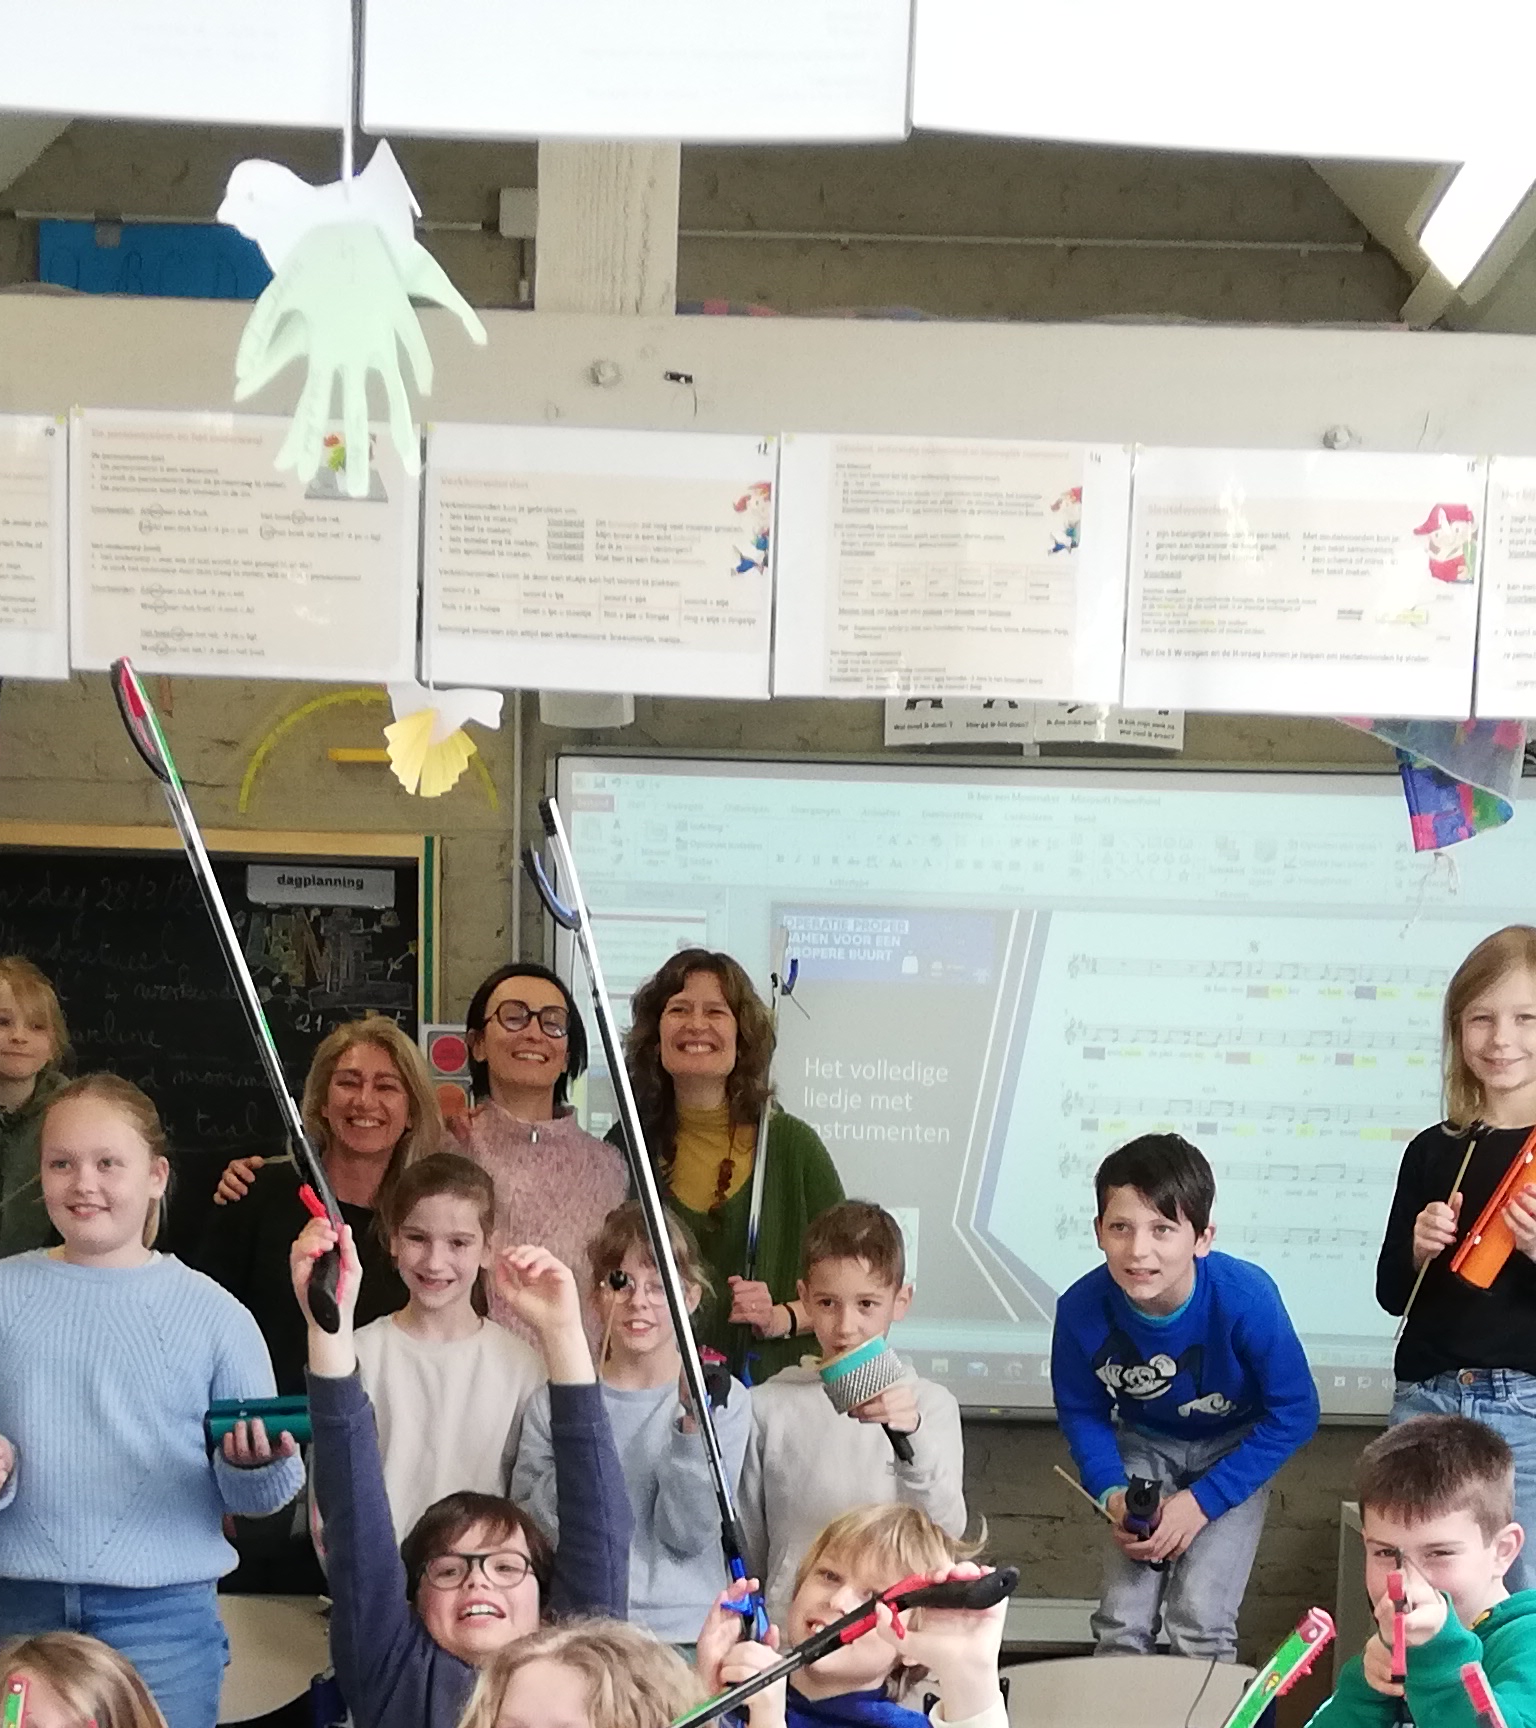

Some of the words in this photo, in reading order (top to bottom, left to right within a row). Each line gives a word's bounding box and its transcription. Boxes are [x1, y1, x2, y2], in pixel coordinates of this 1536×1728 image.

[277, 874, 365, 891] dagplanning
[834, 934, 871, 946] VOOR
[875, 935, 901, 947] EEN
[849, 948, 894, 962] BUURT
[804, 1057, 843, 1080] Het
[850, 1058, 949, 1087] volledige
[803, 1086, 862, 1115] liedje
[870, 1091, 914, 1112] met
[813, 1119, 951, 1145] nstrumenten
